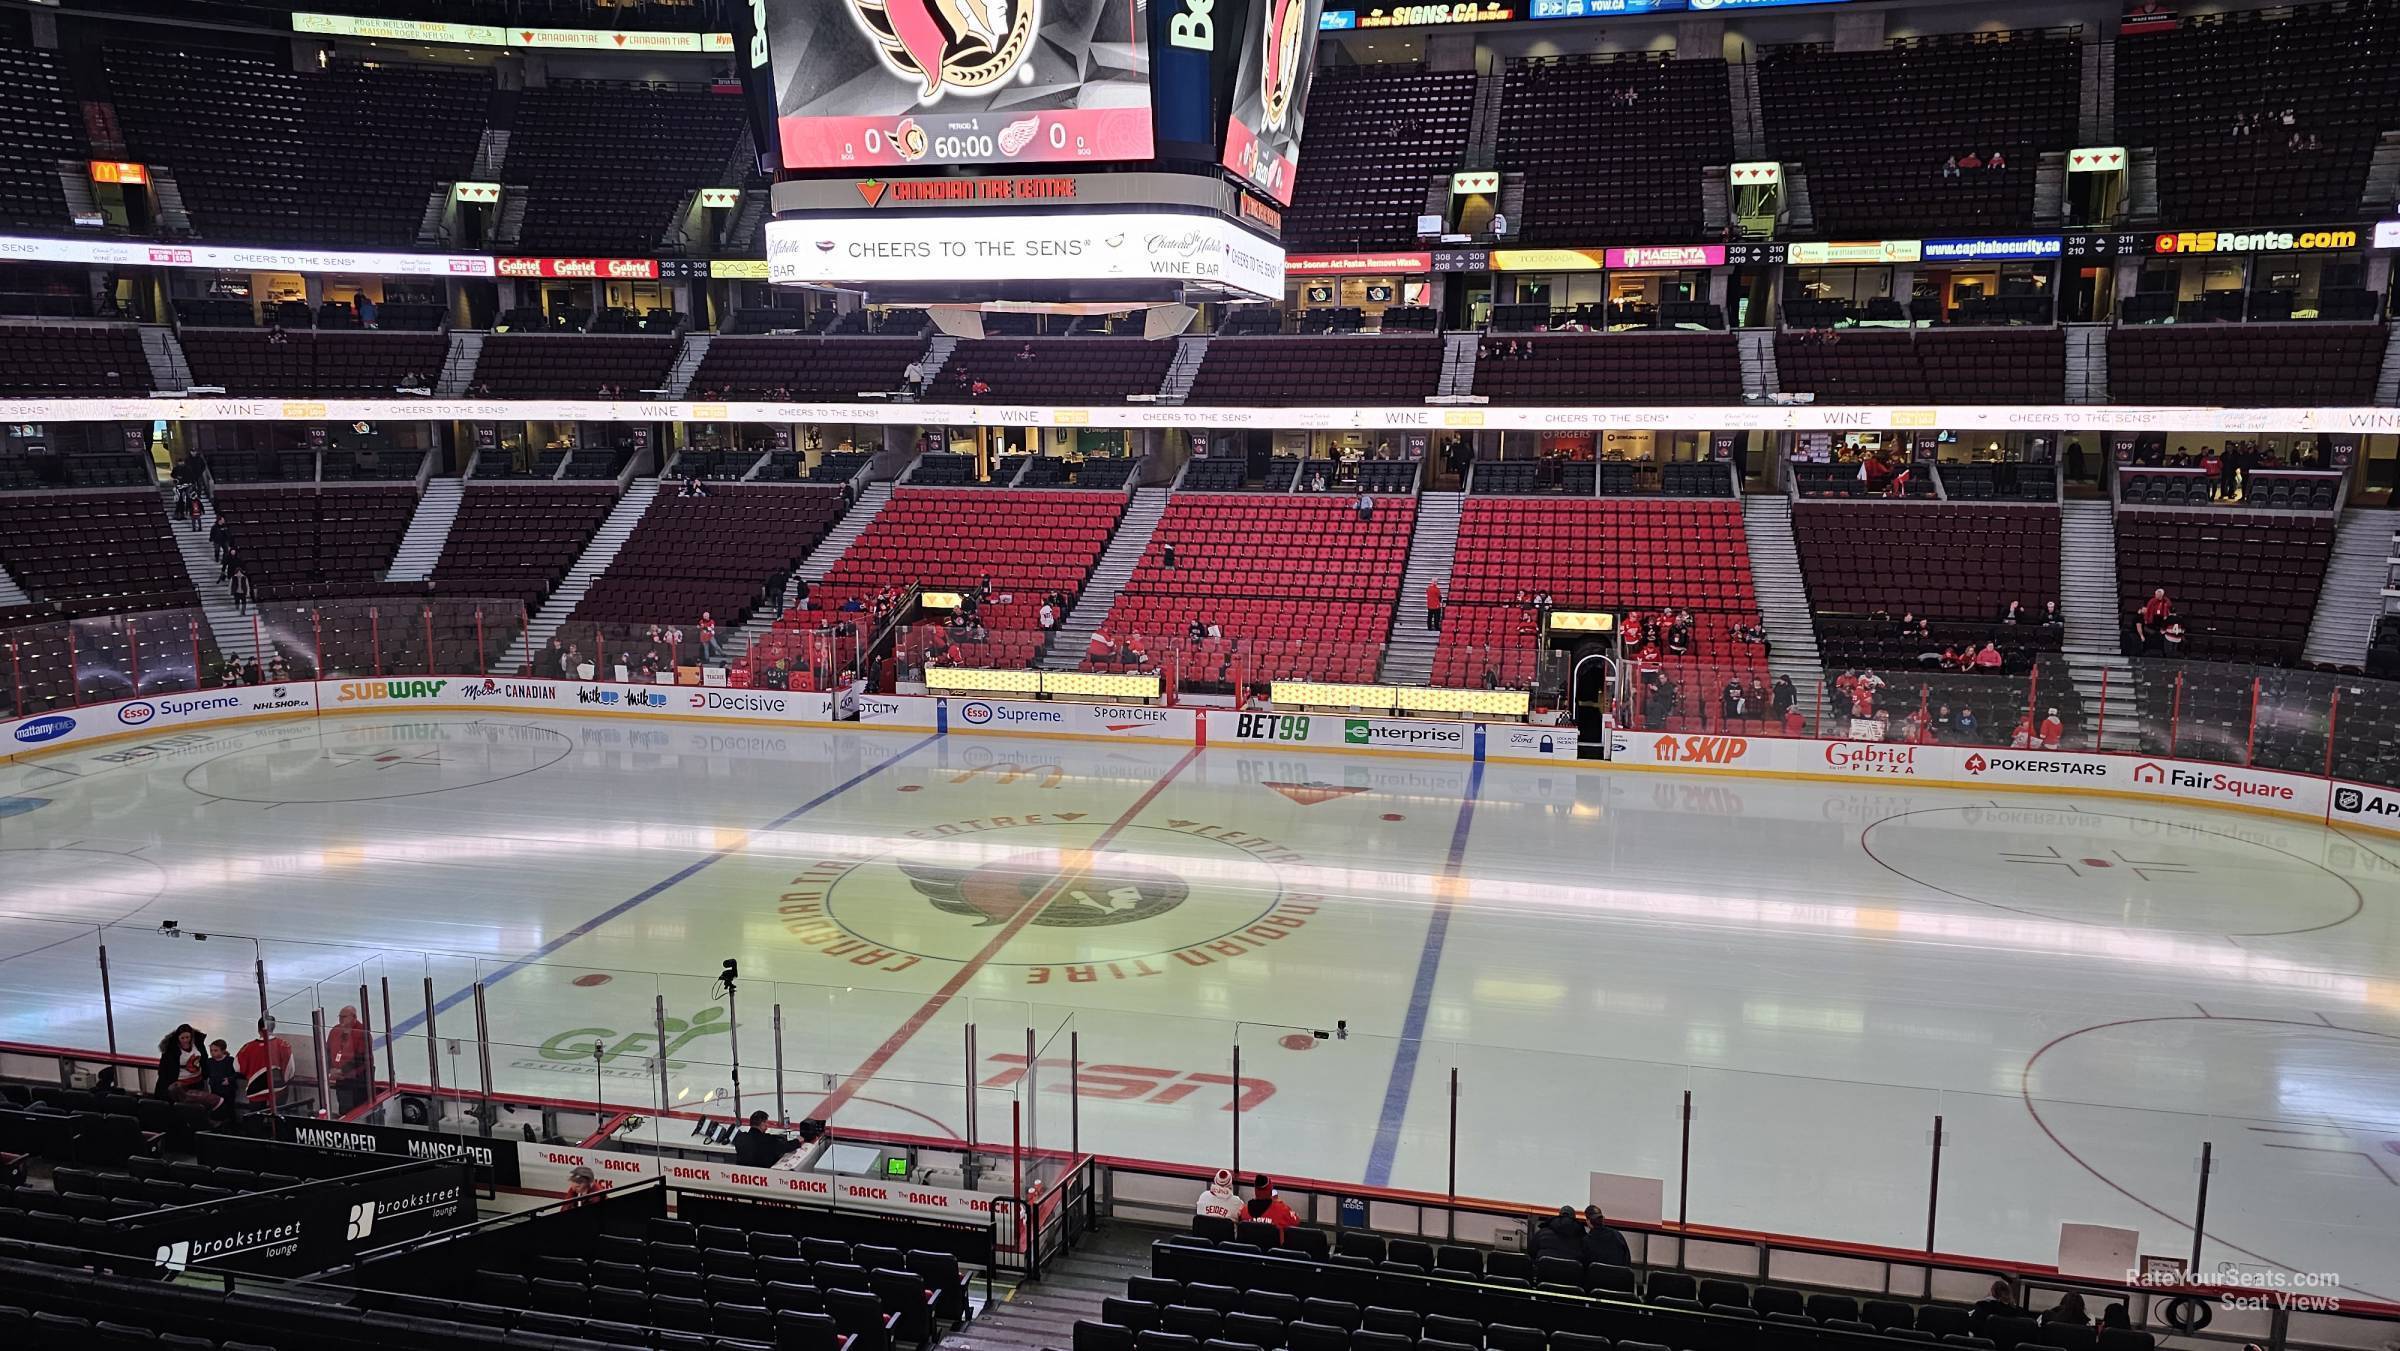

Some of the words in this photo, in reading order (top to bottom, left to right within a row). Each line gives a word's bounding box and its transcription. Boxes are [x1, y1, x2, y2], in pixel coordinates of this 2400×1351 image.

[1391, 2, 1477, 26] SIGNS.CA
[354, 19, 381, 27] ROGER
[383, 20, 415, 29] NEILSON
[360, 27, 392, 36] MAISON
[394, 30, 420, 38] ROGER
[422, 32, 455, 40] NEILSON
[537, 33, 578, 44] CANADIAN
[579, 35, 599, 45] TIRE
[629, 35, 670, 46] CANADIAN
[671, 36, 691, 46] TIRE
[748, 0, 768, 69] Be
[865, 129, 881, 153] 0
[948, 122, 971, 130] PERIOD
[972, 118, 979, 130] 1
[1050, 123, 1066, 148] 0
[845, 143, 852, 153] 0
[935, 135, 993, 158] 60:00
[1076, 136, 1085, 148] 0
[1077, 148, 1091, 156] SOG
[891, 180, 975, 201] CANADIAN
[977, 179, 1014, 198] TIRE
[1019, 178, 1077, 197] CENTRE
[1144, 233, 1192, 254] Chateau
[2069, 237, 2085, 245] 310
[2119, 236, 2134, 244] 311
[849, 242, 930, 258] CHEERS
[939, 242, 965, 257] TO
[975, 241, 1015, 257] THE
[1640, 249, 1706, 259] MAGENTA
[1729, 246, 1746, 254] 309
[1926, 240, 2060, 256] www.capitalsecurity.ca
[2068, 247, 2085, 255] 210
[2118, 246, 2133, 254] 211
[234, 254, 278, 264] CHEERS
[281, 256, 295, 264] TO
[299, 256, 319, 265] THE
[1303, 260, 1329, 269] Sooner.
[1330, 260, 1342, 269] Act
[1343, 259, 1366, 268] Faster.
[1367, 258, 1398, 267] Remove
[1399, 258, 1421, 267] Waste.
[1435, 253, 1450, 261] 308
[1538, 255, 1574, 263] CANADA
[1729, 256, 1746, 264] 209
[1768, 255, 1783, 263] 210
[498, 259, 541, 271] Gabriel
[554, 260, 595, 272] Gabriel
[608, 260, 650, 272] Gabriel
[662, 261, 675, 269] 305
[693, 261, 707, 269] 306
[773, 265, 795, 277] BAR
[1151, 261, 1190, 274] WINE
[1197, 262, 1219, 276] BAR
[216, 404, 265, 416] WINE
[391, 406, 433, 414] CHEERS
[436, 406, 451, 414] TO
[455, 406, 474, 414] THE
[640, 406, 678, 417] WINE
[778, 408, 813, 416] CHEERS
[831, 409, 847, 417] THE
[1000, 411, 1040, 423] WINE
[1142, 413, 1181, 422] CHEERS
[1183, 413, 1197, 422] TO
[1200, 413, 1218, 422] THE
[1386, 412, 1429, 424] WINE
[1545, 414, 1590, 423] CHEERS
[1592, 414, 1607, 423] TO
[1611, 414, 1632, 423] THE
[1823, 412, 1872, 425] WINE
[2010, 413, 2060, 423] CHEERS
[2064, 413, 2081, 423] TO
[2085, 413, 2110, 423] THE
[2349, 414, 2400, 428] WIN
[1554, 430, 1591, 439] ROGERS
[337, 680, 448, 703] SUBWAY
[461, 684, 501, 698] Molson
[505, 684, 556, 700] CANADIAN
[124, 708, 150, 719] Esso
[161, 696, 239, 717] Supreme
[709, 692, 785, 712] Decisive
[967, 708, 988, 718] Esso
[997, 706, 1062, 724] Supreme
[1237, 713, 1310, 741] BET99
[1346, 723, 1461, 743] enterprise
[1511, 733, 1534, 744] Ford
[1680, 736, 1747, 763] SKIP
[1825, 743, 1917, 767] Gabriel
[1852, 763, 1914, 775] PIZZA
[1990, 758, 2107, 776] POKERSTARS
[2171, 769, 2294, 800] FairSquare
[1027, 959, 1163, 984] TIRE
[295, 1127, 376, 1152] MANSCAPED
[549, 1152, 584, 1166] BRICK
[604, 1159, 640, 1173] BRICK
[673, 1166, 710, 1181] BRICK
[731, 1172, 768, 1187] BRICK
[789, 1179, 827, 1193] BRICK
[849, 1185, 887, 1200] BRICK
[377, 1187, 460, 1214] brookstreet
[909, 1192, 947, 1207] BRICK
[970, 1199, 1008, 1214] BRICK
[433, 1205, 458, 1219] lounge
[1205, 1206, 1228, 1217] SEIDER
[193, 1221, 301, 1256] brookstreet
[266, 1243, 297, 1259] lounge
